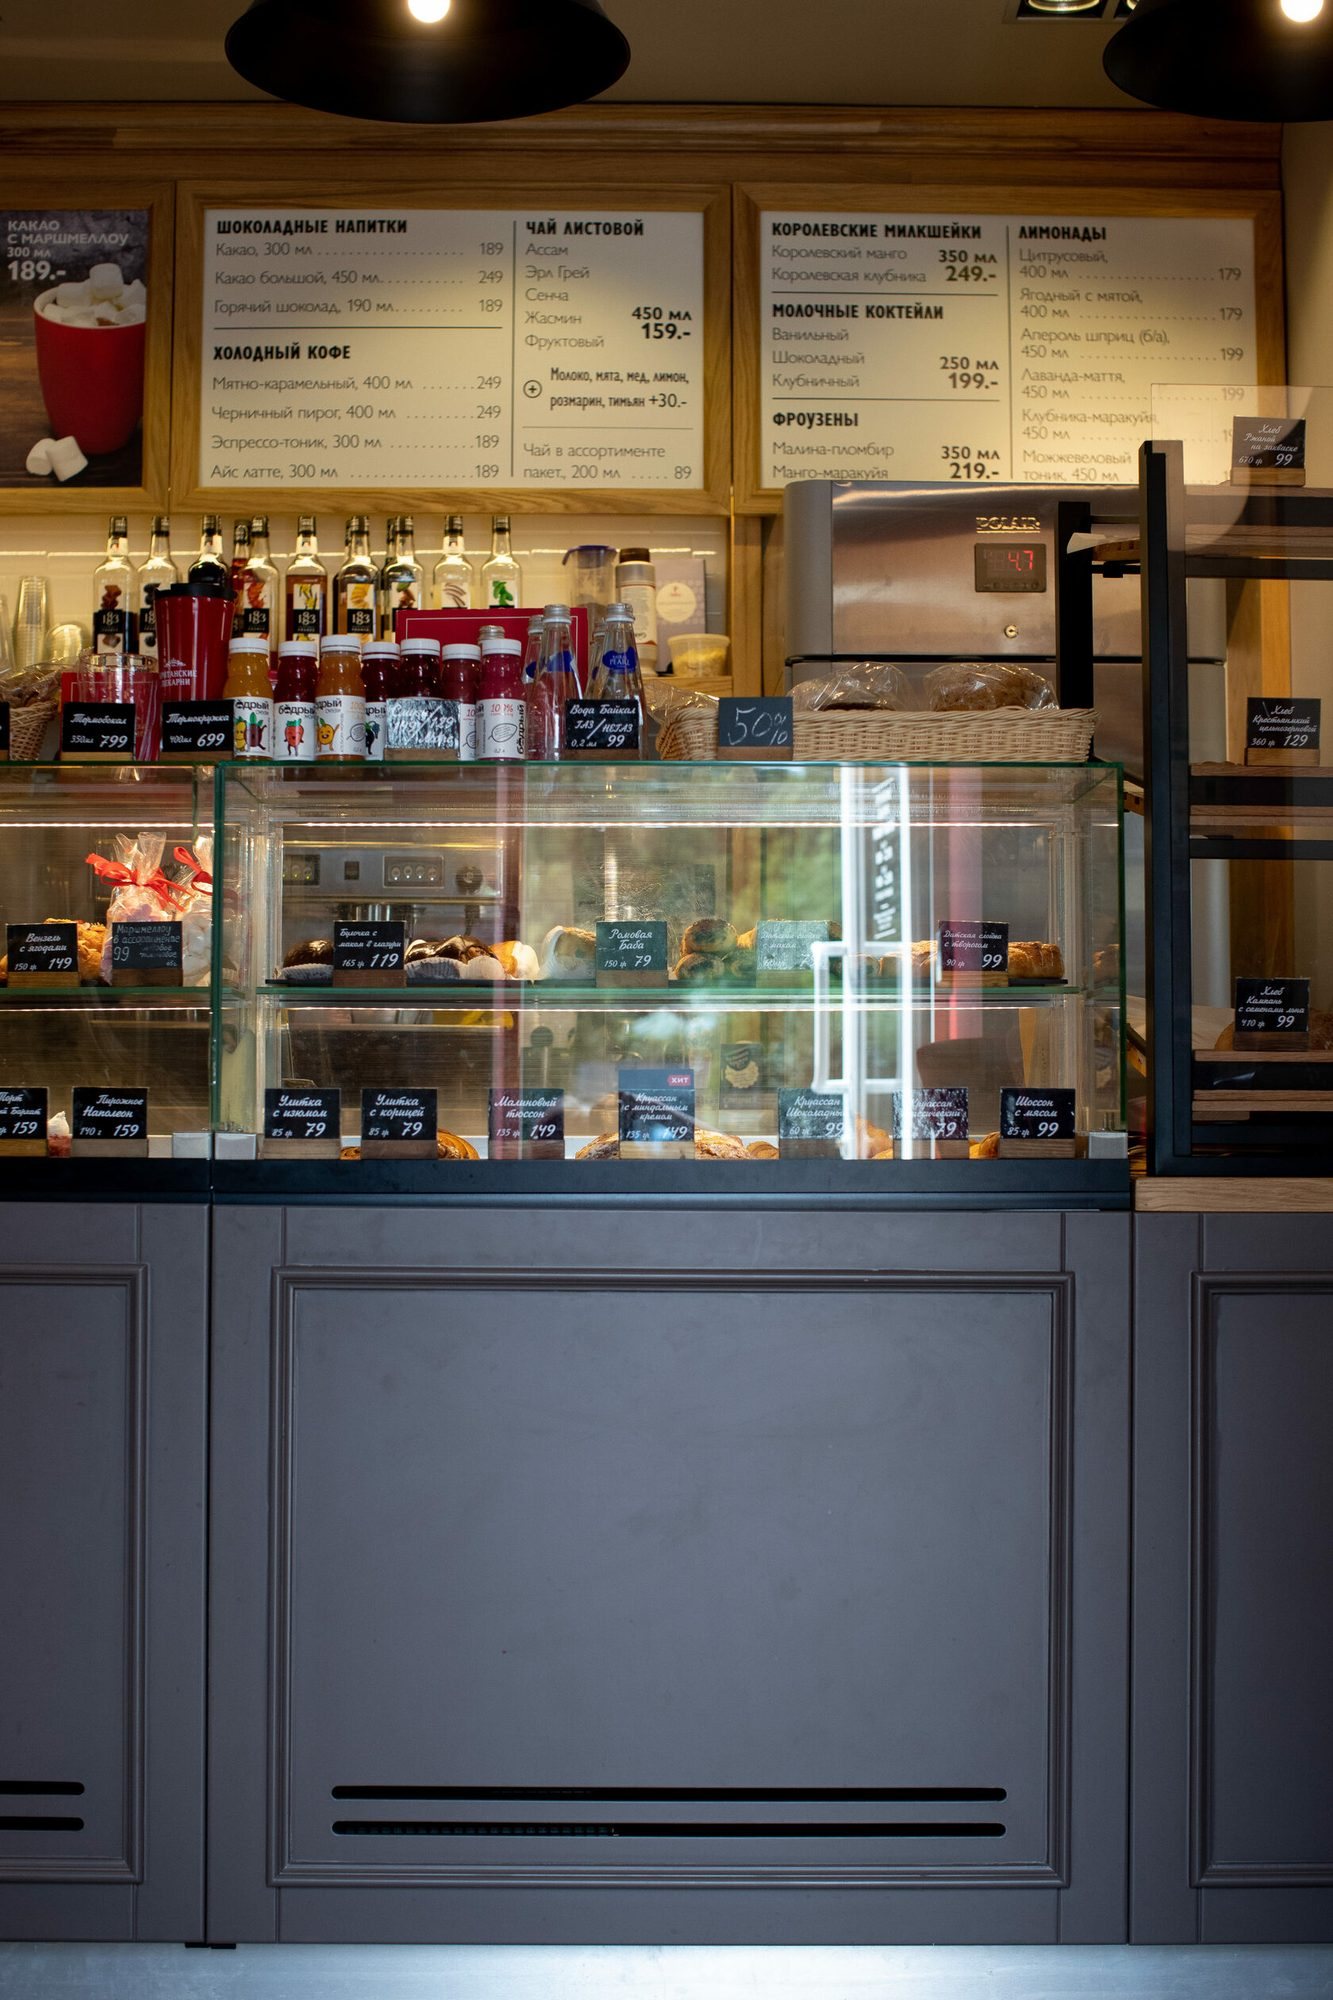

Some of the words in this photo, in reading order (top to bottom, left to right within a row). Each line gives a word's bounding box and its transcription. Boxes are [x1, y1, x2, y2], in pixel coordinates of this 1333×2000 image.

[8, 220, 60, 231] КАКАО
[217, 220, 328, 236] ШОКОЛАДНЫЕ
[335, 220, 407, 234] НАПИТКИ
[526, 218, 556, 236] ЧАЙ
[563, 219, 644, 236] ЛИСТОВОЙ
[772, 222, 878, 238] КОРОЛЕВСКИЕ
[884, 222, 982, 239] МИЛКШЕЙКИ
[8, 234, 17, 244] С
[22, 233, 129, 246] МАРШМЕЛЛОУ
[1018, 225, 1107, 243] ЛИМОНАДЫ
[7, 247, 30, 258] 300
[34, 249, 51, 258] мл
[216, 243, 259, 257] Какао,
[264, 243, 290, 256] 300
[480, 242, 504, 255] 189
[525, 243, 568, 256] Ассам
[772, 245, 862, 260] Королевский
[866, 249, 907, 260] манго
[938, 250, 968, 263] 350
[1019, 249, 1108, 264] Цитрусовый,
[8, 260, 66, 280] 189.-
[525, 266, 554, 280] Эрл
[557, 265, 590, 280] Грей
[772, 268, 859, 282] Королевская
[863, 270, 926, 284] клубника
[945, 265, 996, 282] 249.-
[1019, 265, 1047, 278] 400
[1218, 268, 1241, 281] 179
[215, 271, 255, 285] Какао
[260, 271, 327, 286] большой,
[332, 270, 358, 283] 450
[478, 270, 504, 284] 249
[525, 288, 569, 302] Сенча
[1020, 288, 1080, 302] Ягодный
[1097, 290, 1142, 303] мятой,
[214, 300, 272, 316] Горячий
[276, 300, 341, 315] шоколад,
[347, 299, 372, 312] 190
[479, 299, 503, 312] 189
[631, 307, 662, 320] 450
[669, 311, 692, 320] мл
[772, 304, 859, 318] МОЛОЧНЫЕ
[865, 302, 943, 320] КОКТЕЙЛИ
[1020, 305, 1048, 318] 400
[1220, 308, 1242, 321] 179
[525, 311, 582, 325] Жасмин
[641, 323, 690, 340] 159.-
[772, 328, 849, 341] Ванильный
[1021, 328, 1081, 342] Апероль
[1085, 331, 1134, 344] шприц
[525, 334, 604, 350] Фруктовый
[213, 342, 301, 362] ХОЛОДНЫЙ
[308, 345, 351, 360] КОФЕ
[772, 351, 865, 366] Шоколадный
[1021, 345, 1047, 358] 450
[1221, 348, 1244, 361] 199
[940, 356, 970, 370] 250
[550, 367, 593, 382] Молоко,
[595, 371, 623, 383] мята,
[653, 372, 689, 384] лимон,
[772, 374, 860, 390] Клубничный
[948, 373, 998, 389] 199.-
[213, 376, 359, 393] Мятно-карамельный,
[363, 376, 391, 390] 400
[477, 376, 502, 390] 249
[1021, 386, 1048, 398] 450
[1221, 388, 1244, 401] 199
[550, 395, 605, 410] розмарин,
[608, 396, 645, 407] тимьян
[212, 406, 293, 419] Черничный
[298, 408, 341, 422] пирог,
[346, 406, 373, 419] 400
[477, 405, 502, 419] 249
[773, 412, 858, 429] ФРОУЗЕНЫ
[1022, 426, 1048, 439] 450
[211, 435, 327, 452] Эспрессо-тоник,
[332, 434, 359, 448] 300
[475, 435, 499, 448] 189
[523, 443, 550, 457] Чай
[567, 446, 666, 460] ассортименте
[772, 442, 894, 460] Малина-пломбир
[941, 446, 970, 459] 350
[1023, 450, 1131, 465] Можжевеловый
[1275, 454, 1293, 466] 99
[210, 464, 239, 479] Айс
[243, 467, 283, 480] латте,
[288, 464, 316, 478] 300
[475, 464, 499, 478] 189
[571, 465, 598, 479] 200
[674, 466, 692, 479] 89
[772, 467, 888, 480] Манго-маракуйя
[950, 462, 999, 479] 219.-
[1072, 468, 1097, 481] 450
[570, 704, 594, 715] Вода
[599, 704, 636, 714] Байкал
[70, 713, 127, 726] Термобокал
[166, 712, 230, 725] Термокружка
[100, 734, 128, 748] 799
[197, 733, 225, 747] 699
[607, 734, 625, 747] 99
[1283, 734, 1308, 746] 129
[25, 933, 61, 943] Вензель
[340, 928, 370, 938] Булочка
[609, 929, 652, 939] Ромовая
[28, 945, 67, 954] ягодами
[619, 940, 644, 950] Баба
[113, 946, 130, 962] 99
[370, 953, 399, 967] 119
[635, 955, 651, 967] 79
[982, 954, 1002, 968] 99
[48, 957, 72, 969] 149
[1276, 1016, 1295, 1027] 99
[278, 1095, 322, 1107] Улитка
[375, 1094, 419, 1106] Улитка
[494, 1096, 558, 1107] Малиновый
[635, 1092, 677, 1104] Круассан
[794, 1096, 840, 1108] Круассан
[1015, 1095, 1053, 1107] Шоссон
[83, 1106, 133, 1118] Наполеон
[283, 1109, 327, 1117] изюмом
[379, 1106, 425, 1120] корицей
[631, 1104, 688, 1114] миндальным
[640, 1114, 672, 1122] кремом
[12, 1122, 38, 1134] 159
[113, 1124, 139, 1136] 159
[272, 1129, 283, 1137] 85
[304, 1122, 326, 1136] 79
[368, 1128, 380, 1136] 85
[401, 1121, 423, 1136] 79
[530, 1124, 556, 1137] 149
[626, 1130, 640, 1139] 135
[662, 1126, 688, 1139] 149
[825, 1122, 844, 1136] 99
[935, 1122, 957, 1137] 79
[1007, 1127, 1018, 1136] 85
[1037, 1122, 1059, 1137] 99
